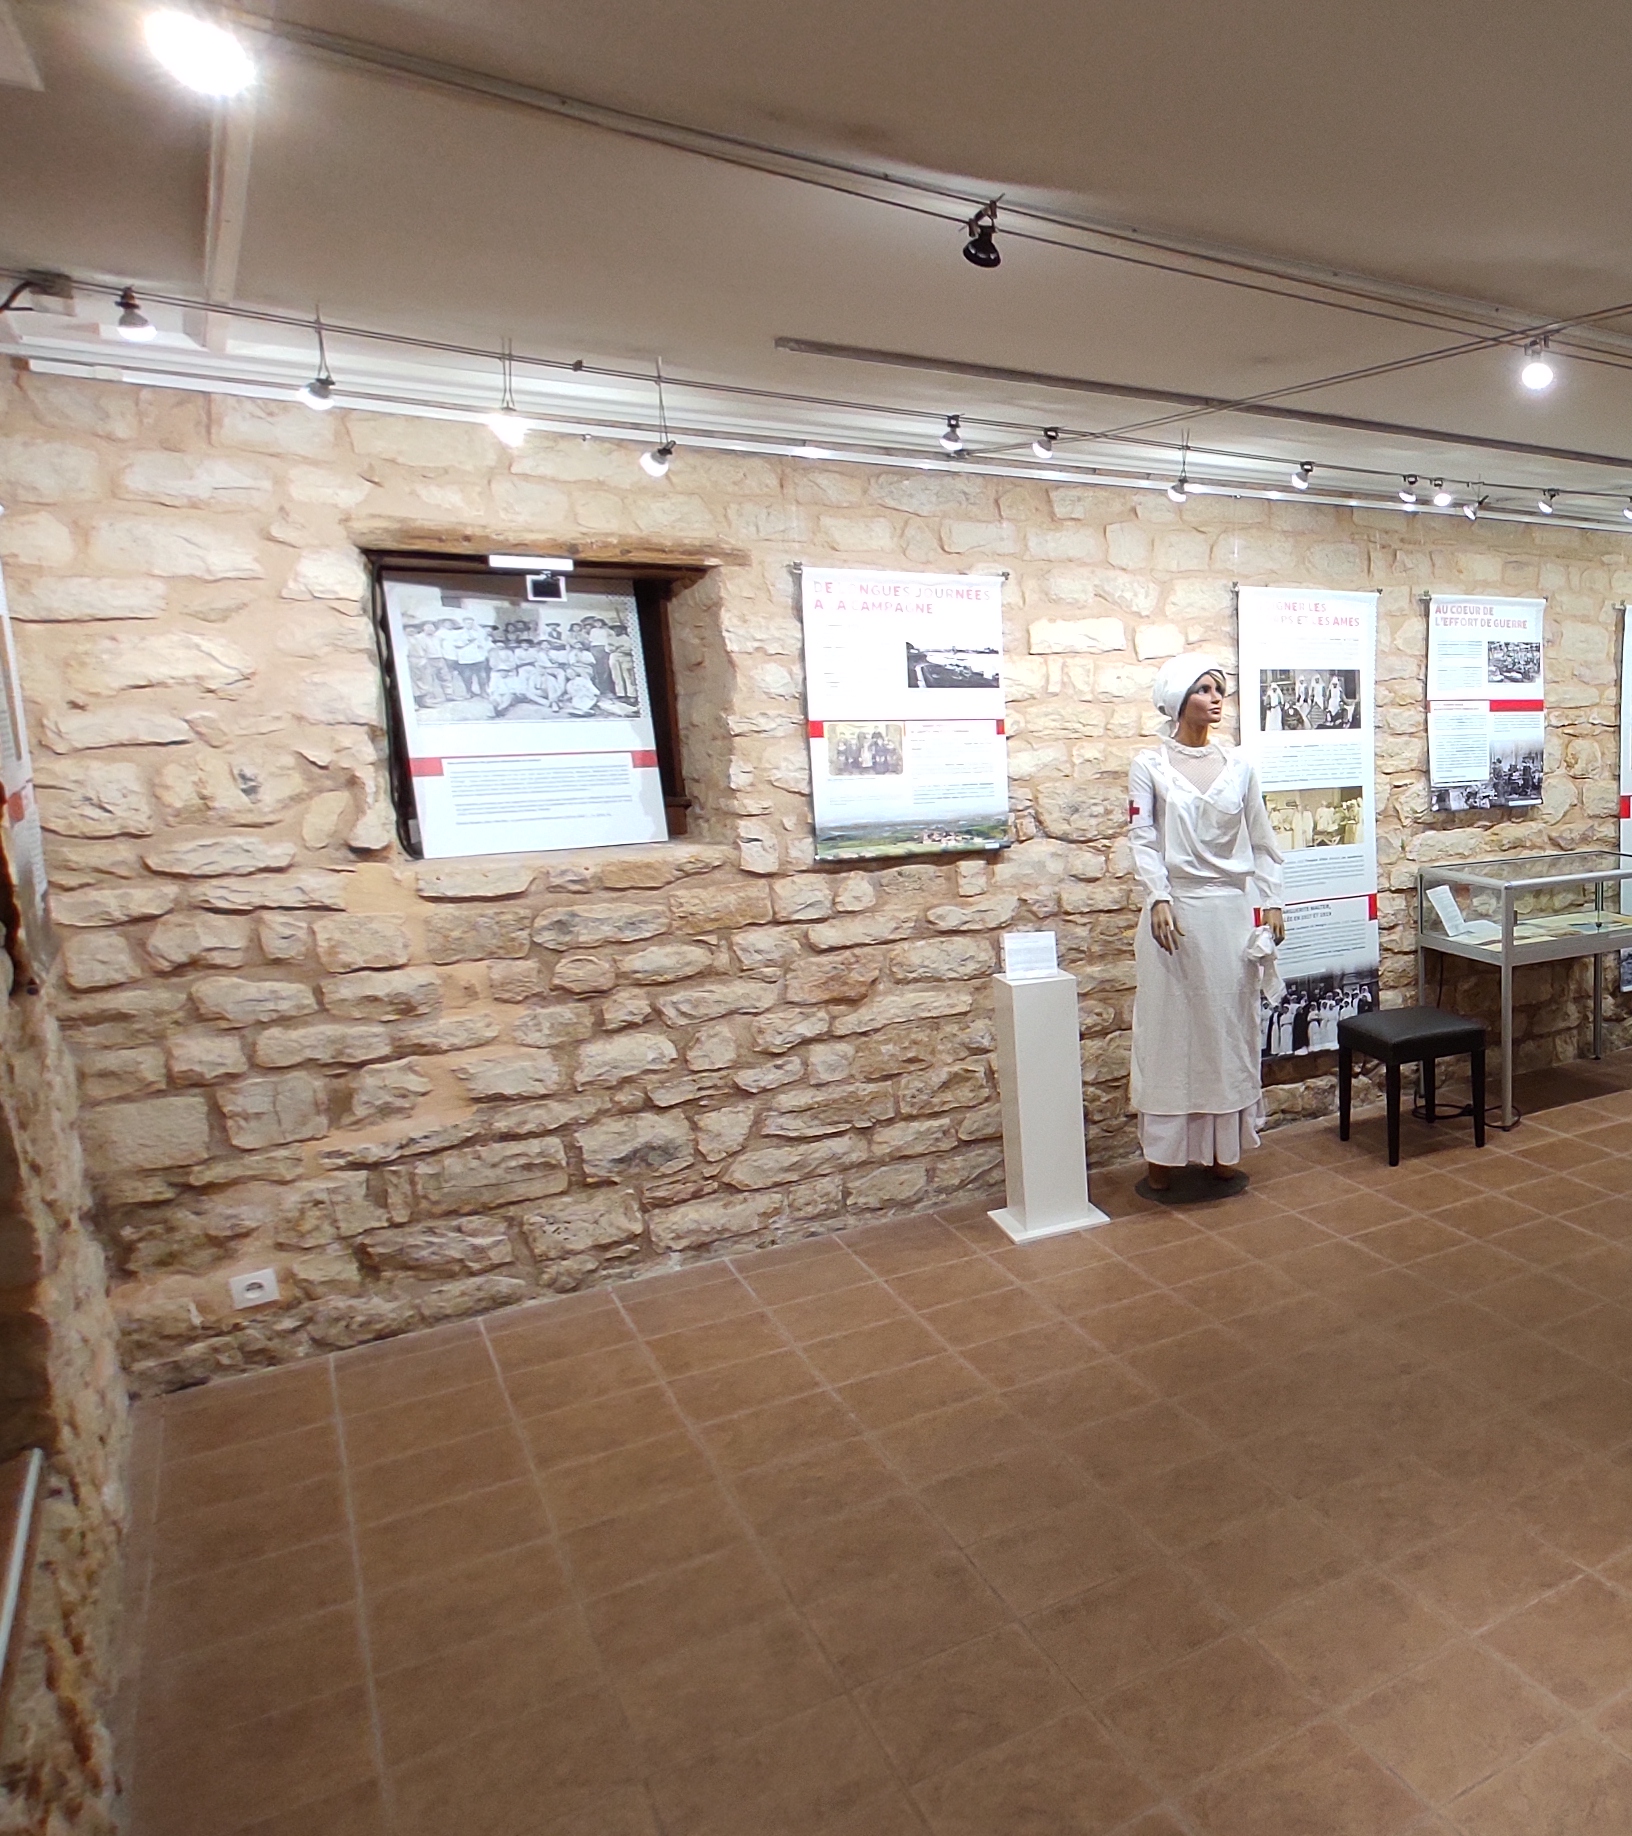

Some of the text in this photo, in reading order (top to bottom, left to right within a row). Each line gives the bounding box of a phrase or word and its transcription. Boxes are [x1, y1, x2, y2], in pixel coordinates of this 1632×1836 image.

[813, 580, 833, 594] DE
[1435, 604, 1494, 616] AU COEUR DE
[1435, 616, 1528, 629] L'EFFORT DE GUERRE
